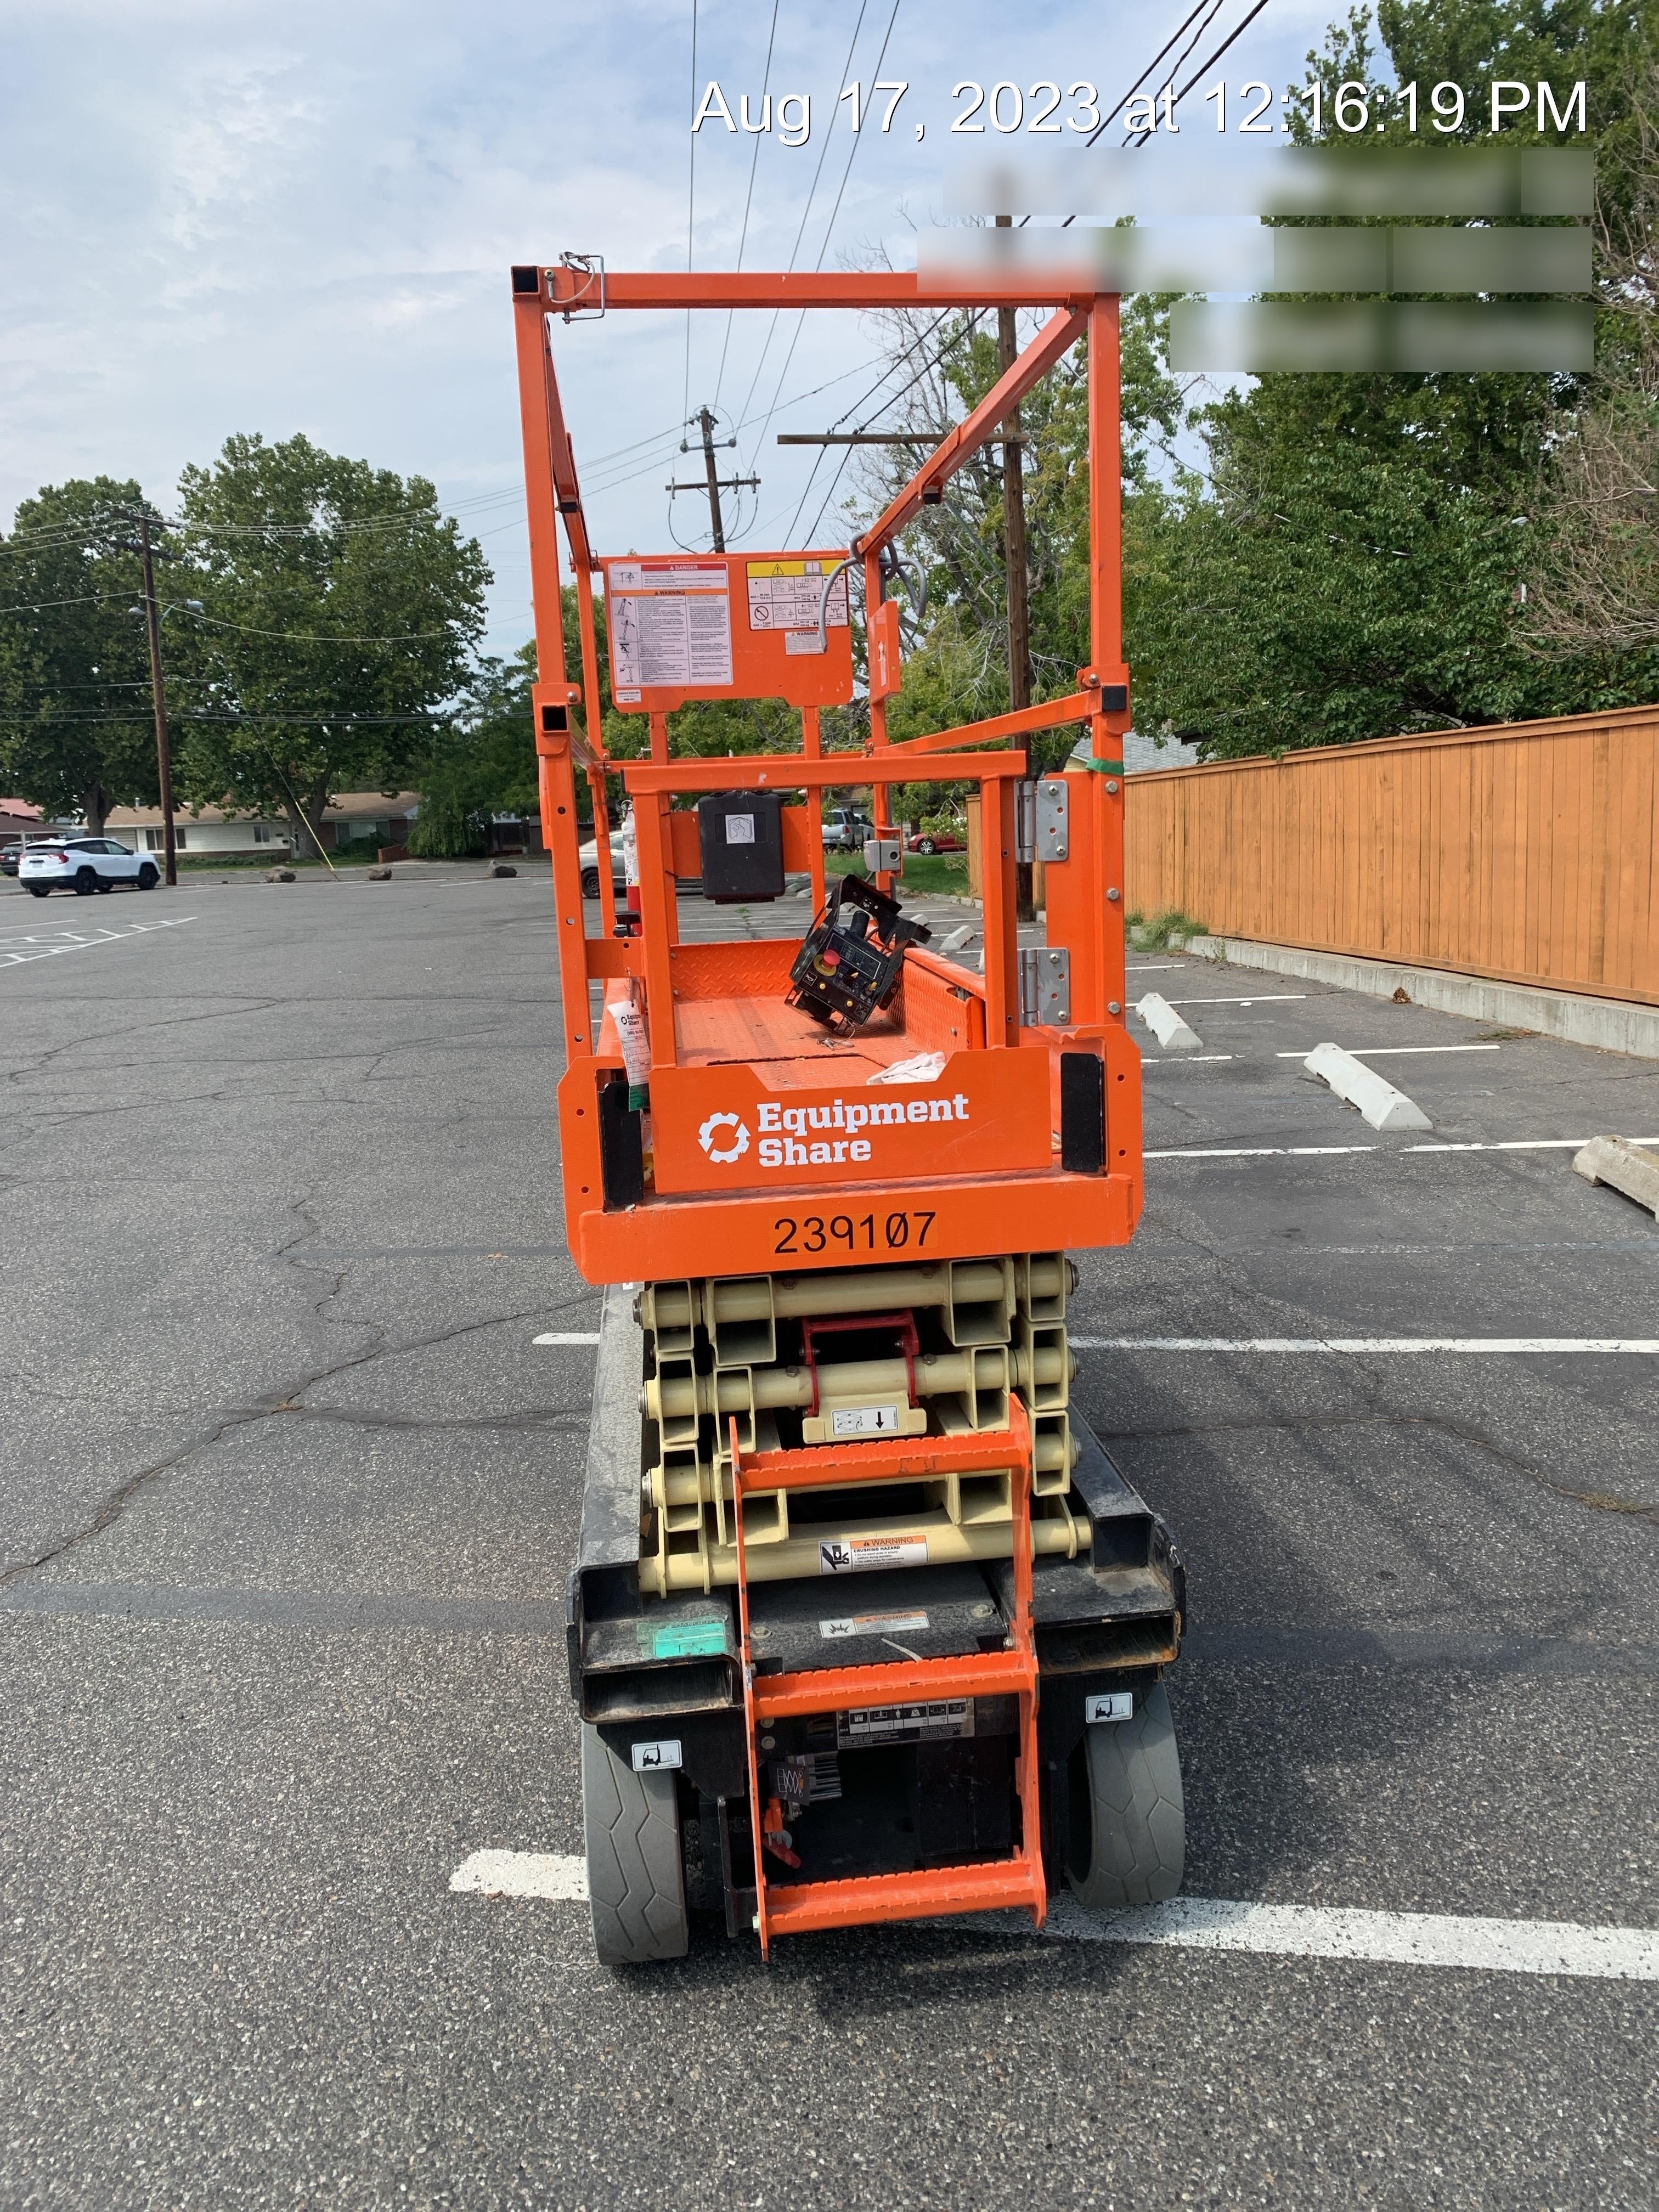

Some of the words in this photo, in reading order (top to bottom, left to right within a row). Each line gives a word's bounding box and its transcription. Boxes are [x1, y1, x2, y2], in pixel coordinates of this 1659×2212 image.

[757, 1093, 969, 1137] Equipment
[758, 1138, 872, 1167] Share
[774, 1211, 936, 1254] 239107
[871, 1537, 913, 1546] WARNING
